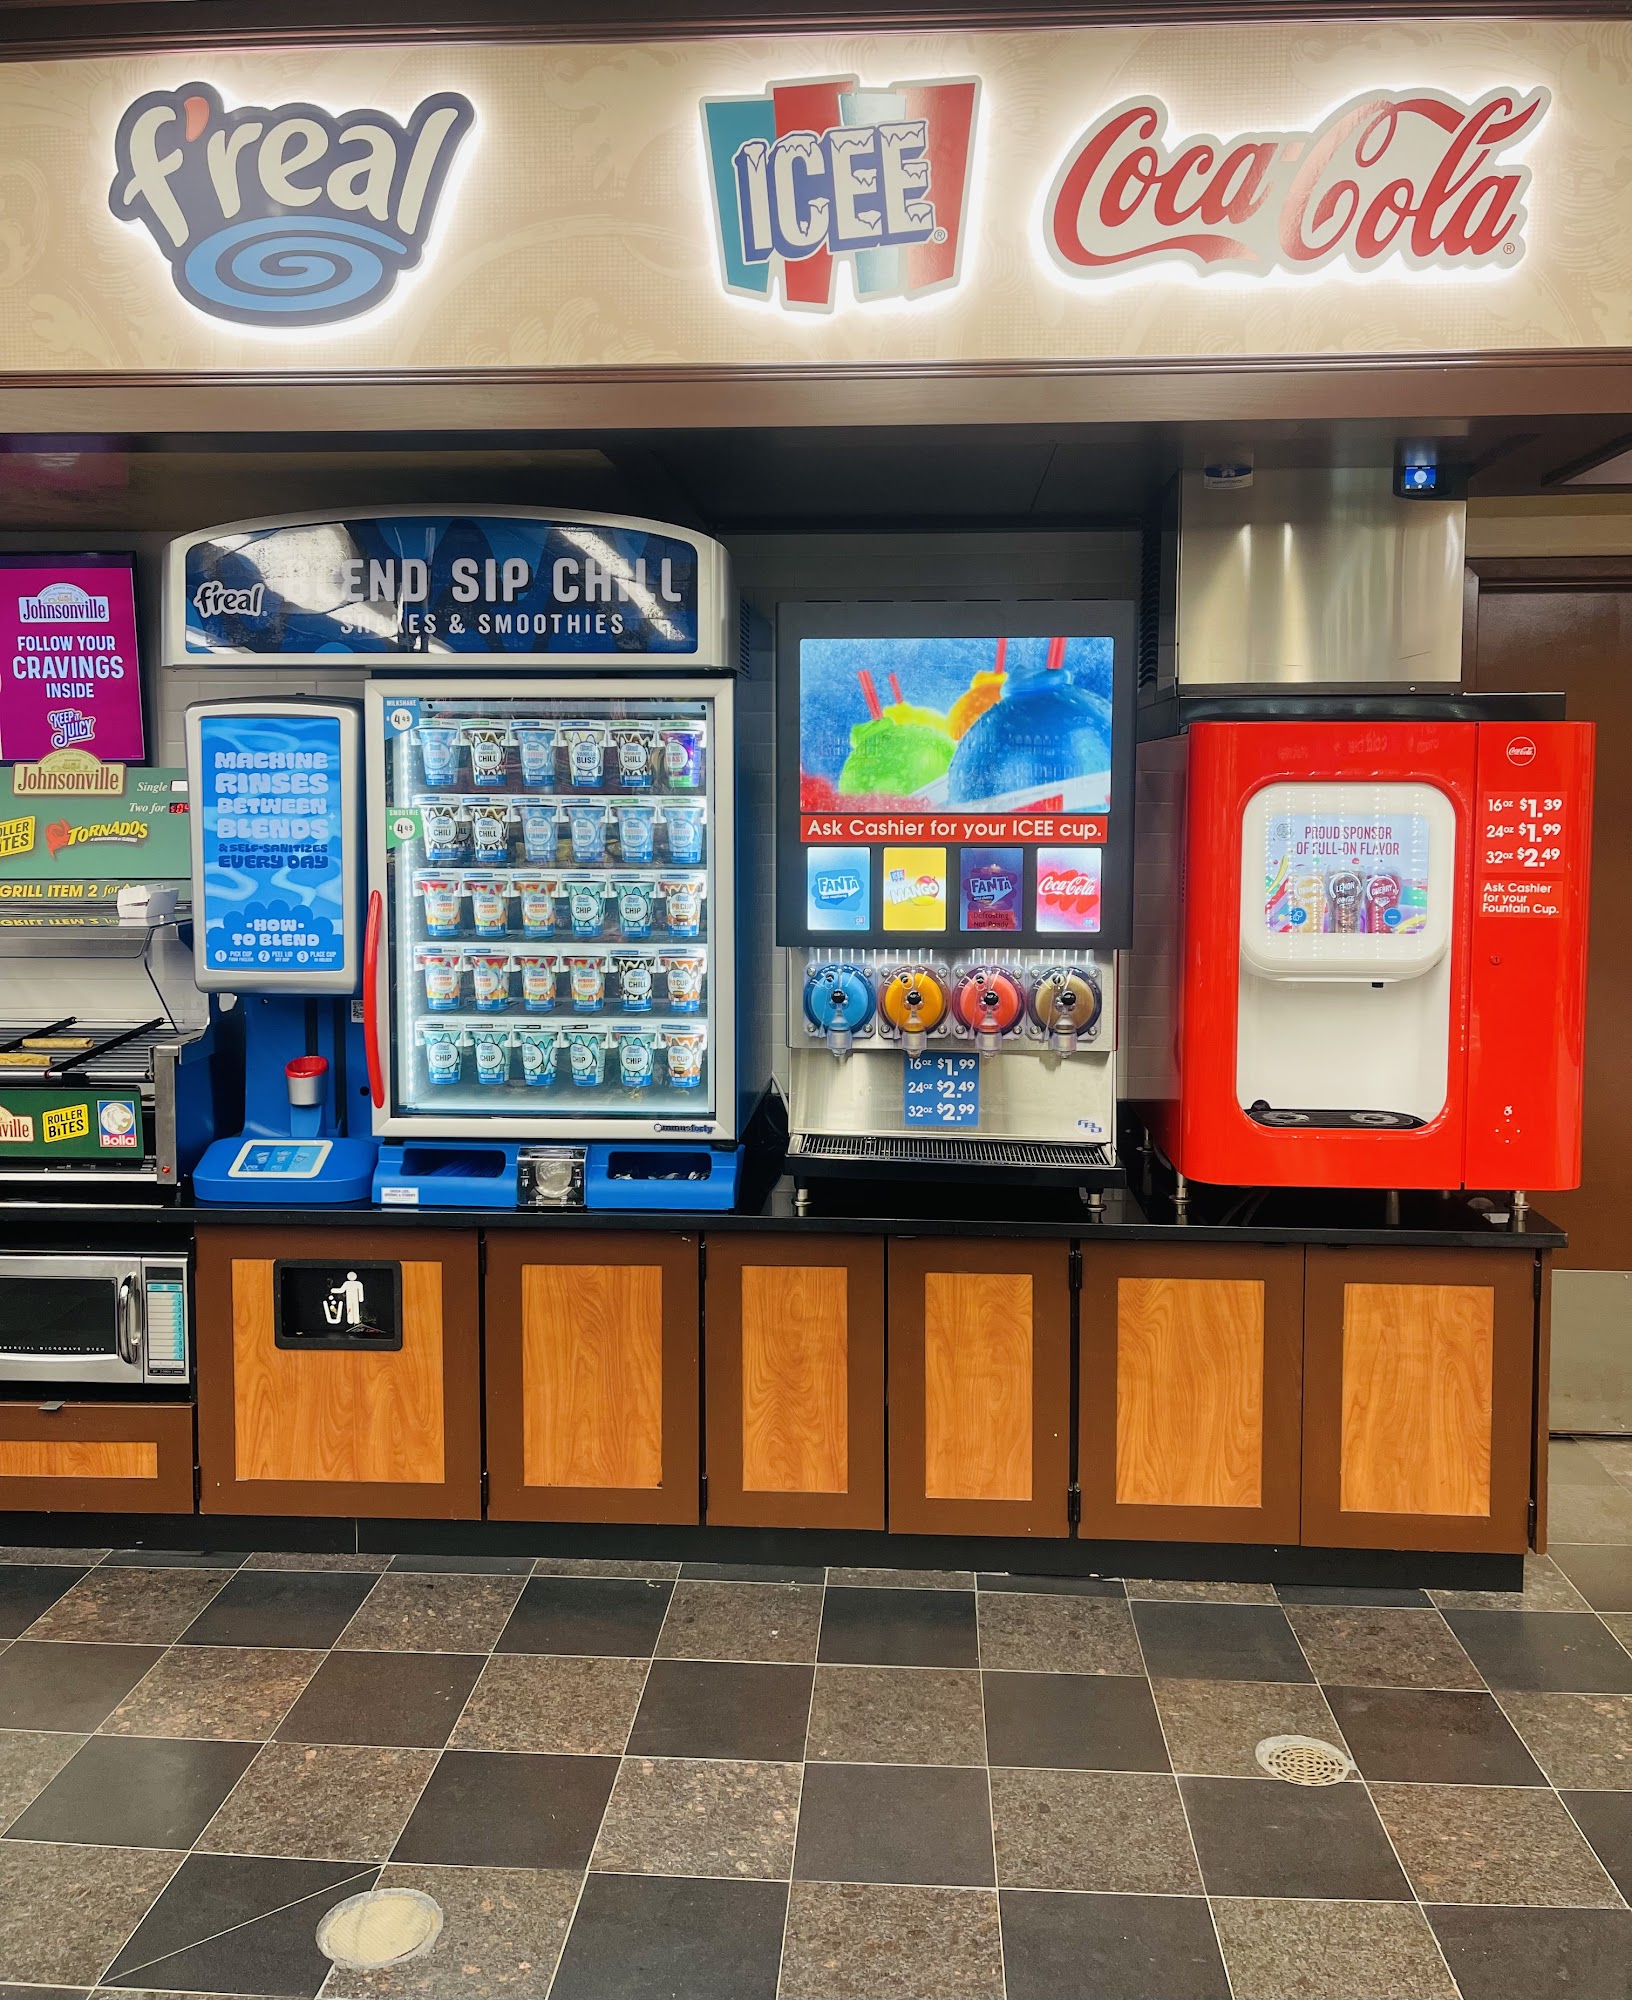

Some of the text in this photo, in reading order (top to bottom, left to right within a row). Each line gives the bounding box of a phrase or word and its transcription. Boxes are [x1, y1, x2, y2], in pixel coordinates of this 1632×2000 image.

[124, 95, 459, 249] f'real
[1053, 96, 1542, 266] Coca-Cola
[733, 120, 936, 262] ICEE
[295, 559, 428, 602] END
[452, 558, 530, 602] SIP
[196, 581, 265, 618] f'real
[23, 599, 106, 620] Johnsonville
[340, 613, 625, 635] SHKES & SMOOTHIES
[17, 636, 116, 651] FOLLOW YOUR
[12, 655, 124, 680] CRAVINGS
[46, 682, 95, 698] INSIDE
[386, 699, 417, 707] MILKSHAKE
[50, 711, 74, 728] KEEP
[394, 714, 401, 725] 4
[53, 719, 93, 748] JUICY
[214, 752, 329, 769] MACHINE
[624, 755, 642, 763] CHILL
[17, 766, 119, 791] Johnsonville
[215, 773, 329, 795] RINSES
[136, 781, 168, 794] Single
[129, 803, 166, 815] Two for
[217, 797, 327, 815] BETWEEN
[1488, 797, 1562, 818] 16oz $1.39
[67, 820, 148, 846] TORNADOS
[216, 818, 329, 840] BLENDS
[397, 824, 404, 833] 4
[478, 830, 497, 838] CHILL
[807, 819, 1102, 840] Ask Cashier for your ICEE cup.
[1304, 826, 1340, 839] PROUD
[1343, 826, 1393, 839] SPONSOR
[1486, 822, 1562, 842] 24oz $1.99
[218, 843, 328, 853] & SELF-SANITIZES
[1296, 841, 1400, 855] OF FULL-ON FLAVOR
[218, 854, 329, 870] EVERY DAY
[1485, 847, 1561, 867] 32oz $2.49
[0, 884, 120, 897] GRILL ITEM 2 for
[819, 876, 860, 893] FANTA
[971, 877, 1012, 893] FANTA
[1038, 875, 1097, 896] Coca-Cola
[1336, 881, 1355, 893] LEMON
[1371, 885, 1394, 896] CHERRY
[1483, 882, 1552, 894] Ask Cashier
[890, 881, 940, 905] MANGO
[1483, 893, 1528, 905] for your
[625, 907, 642, 915] CHIP
[973, 911, 1009, 921] Defrosting
[1482, 903, 1560, 915] Fountain Cup.
[973, 920, 986, 928] Not
[231, 933, 320, 947] TO BLEND
[434, 1054, 452, 1062] CHIP
[572, 1056, 586, 1064] CHIP
[909, 1057, 976, 1076] 16oz $1.99
[908, 1079, 976, 1098] 24oz $2.49
[47, 1109, 83, 1125] ROLLER
[908, 1102, 976, 1121] 32oz $2.99
[102, 1134, 136, 1146] Bolla
